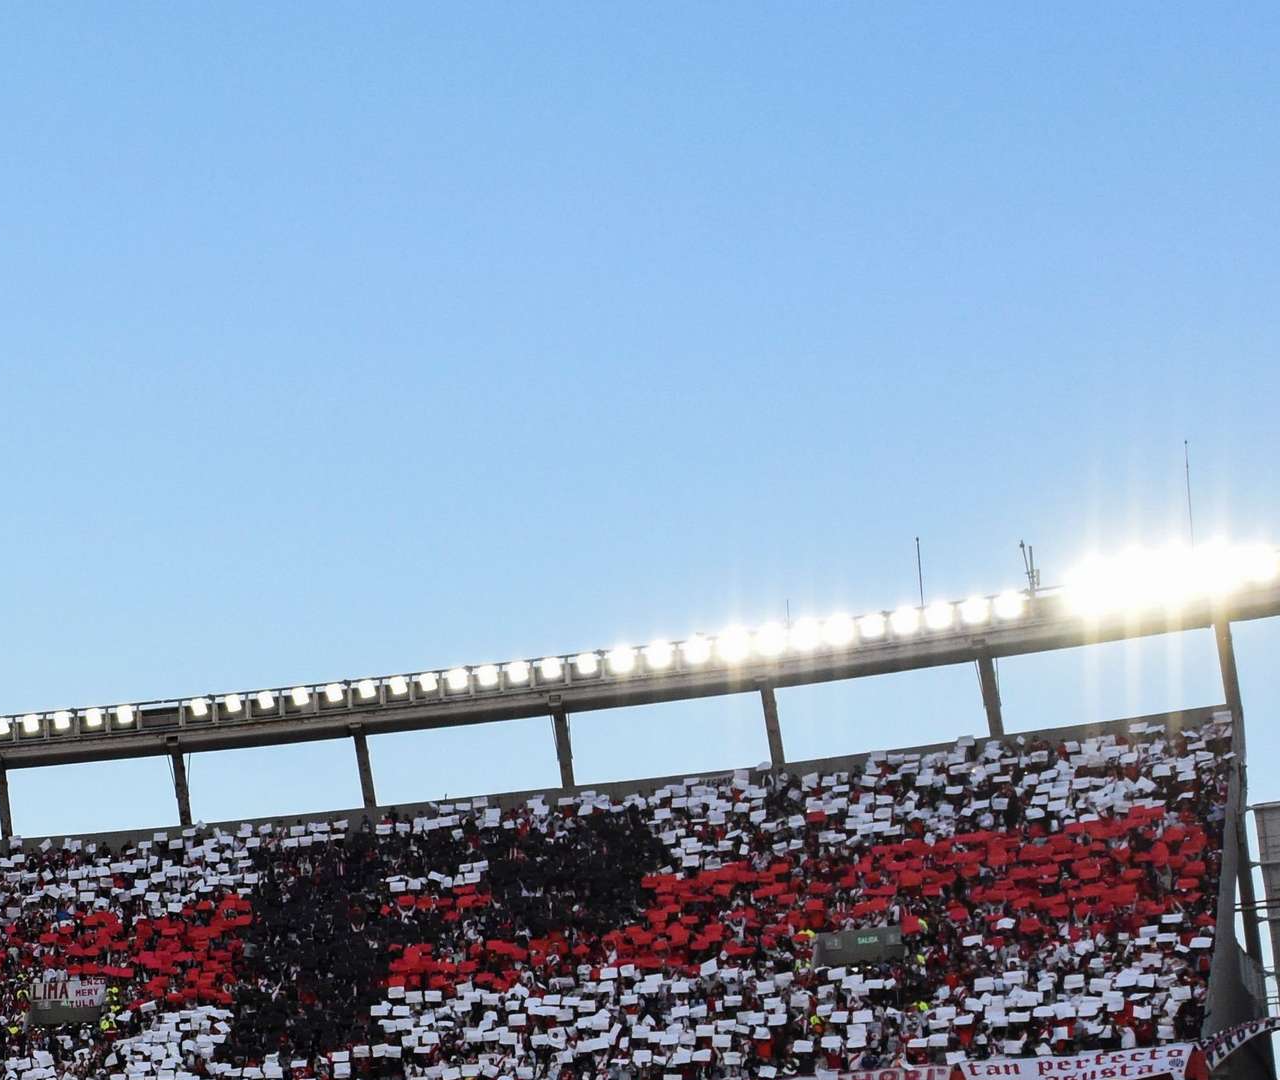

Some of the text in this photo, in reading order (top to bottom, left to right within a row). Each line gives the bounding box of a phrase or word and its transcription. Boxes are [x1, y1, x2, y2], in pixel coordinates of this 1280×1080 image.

[32, 983, 69, 999] LIMA
[967, 1047, 1185, 1076] tan perfecto
